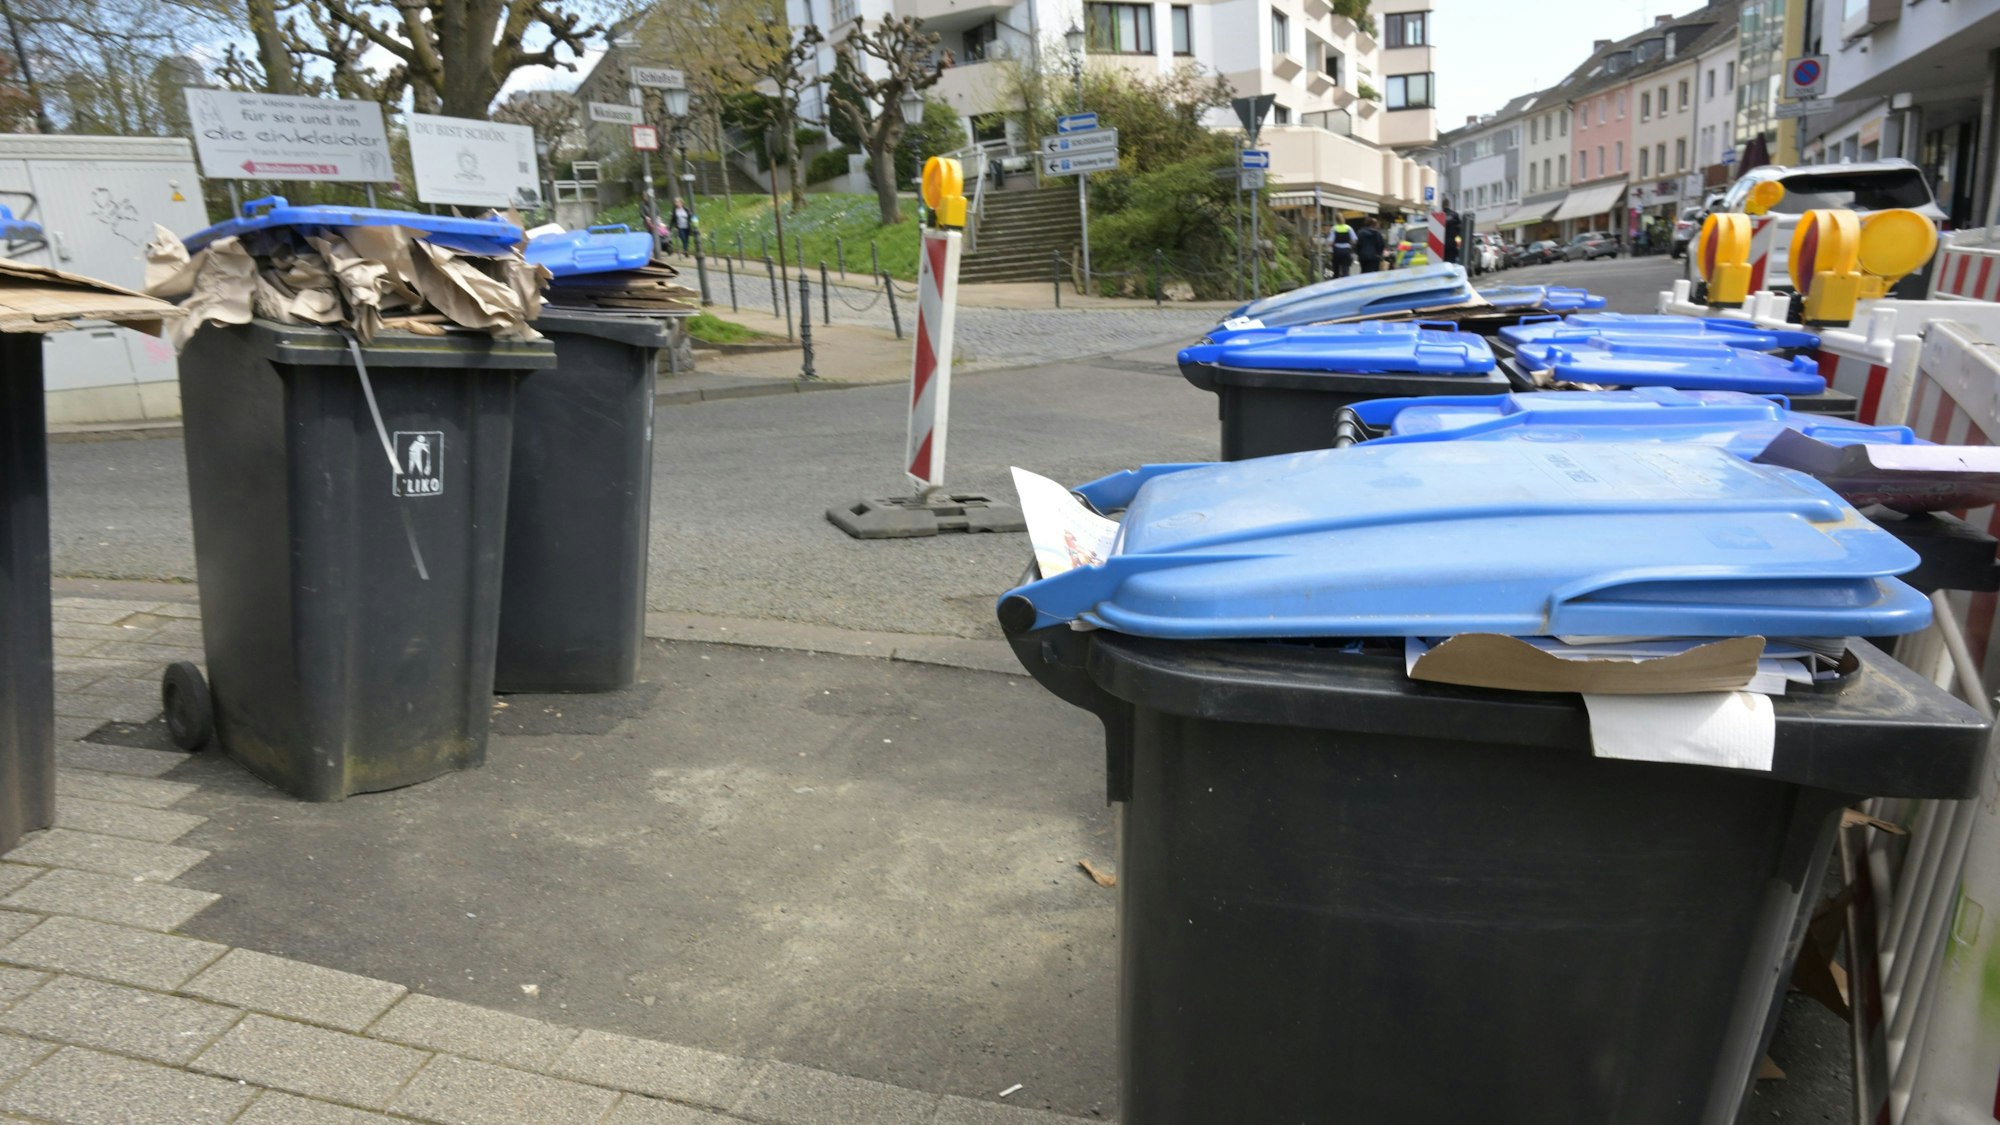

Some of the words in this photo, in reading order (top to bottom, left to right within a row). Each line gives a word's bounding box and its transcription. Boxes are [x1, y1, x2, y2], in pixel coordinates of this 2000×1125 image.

[238, 97, 256, 105] der
[262, 99, 296, 108] kleine
[241, 108, 265, 121] für
[273, 111, 296, 123] sie
[302, 113, 332, 126] und
[337, 115, 361, 127] ihn
[204, 125, 247, 141] die
[255, 128, 382, 147] einkleider
[415, 122, 433, 135] DU
[436, 124, 463, 137] BIST
[397, 478, 440, 493] LIKO
